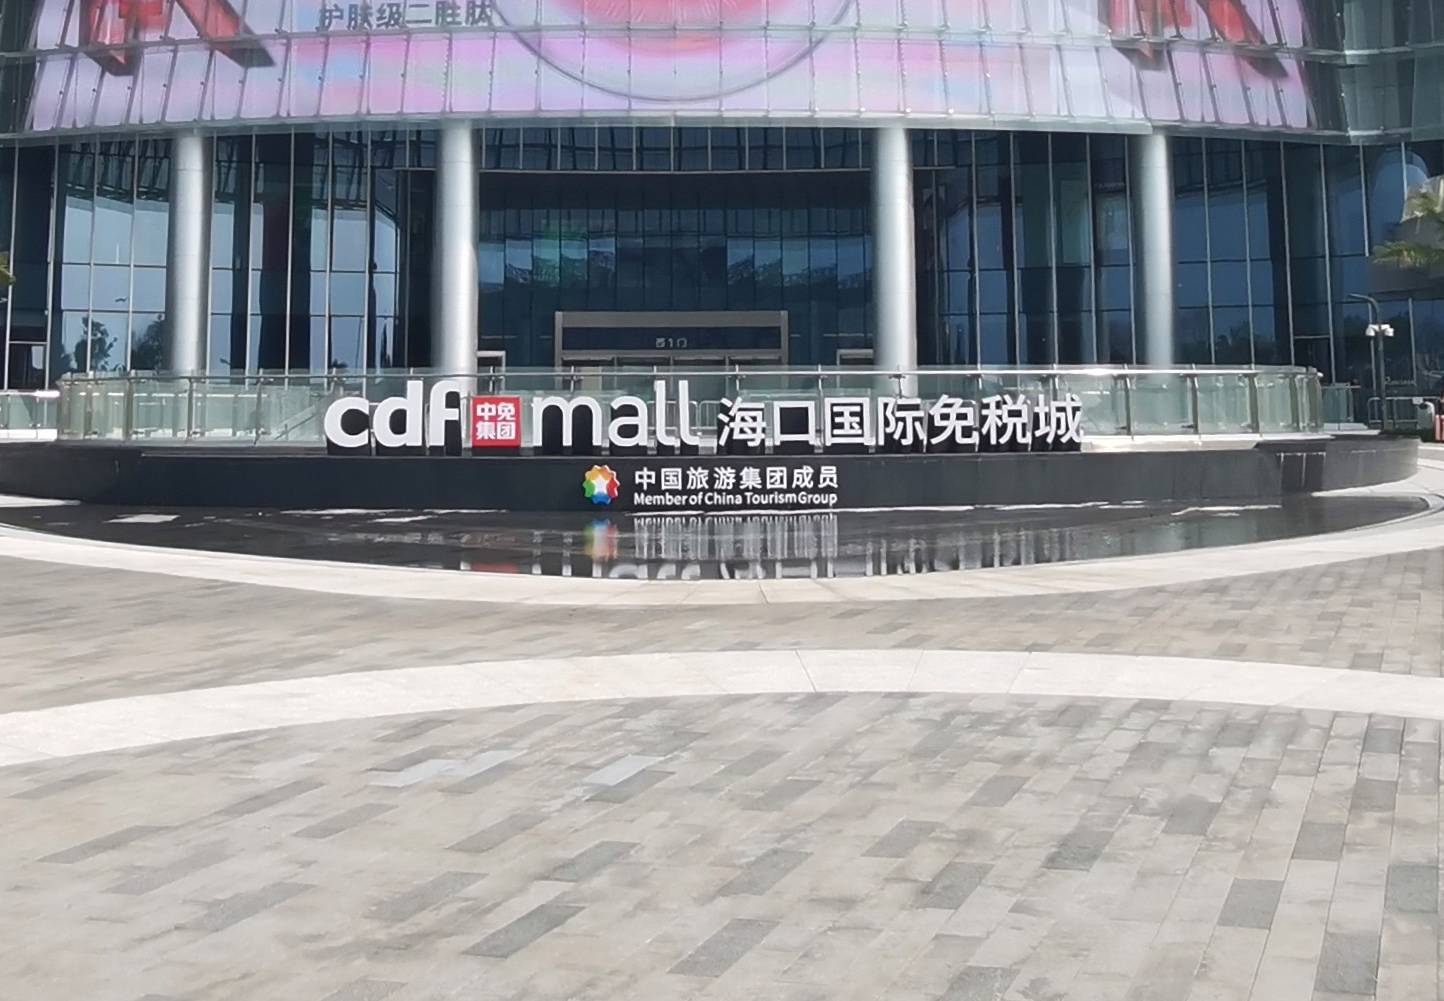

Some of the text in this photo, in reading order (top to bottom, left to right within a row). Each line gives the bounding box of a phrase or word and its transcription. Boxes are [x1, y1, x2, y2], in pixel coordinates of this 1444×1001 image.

[316, 0, 492, 31] 护肤级二胜肽
[324, 379, 465, 449] cdf
[476, 402, 516, 421] 中免
[532, 380, 1084, 448] mall 海口国际免税城
[476, 422, 516, 441] 集团
[634, 465, 839, 490] 中国旅游集团成员
[634, 491, 838, 507] Member of China Tourism Group
